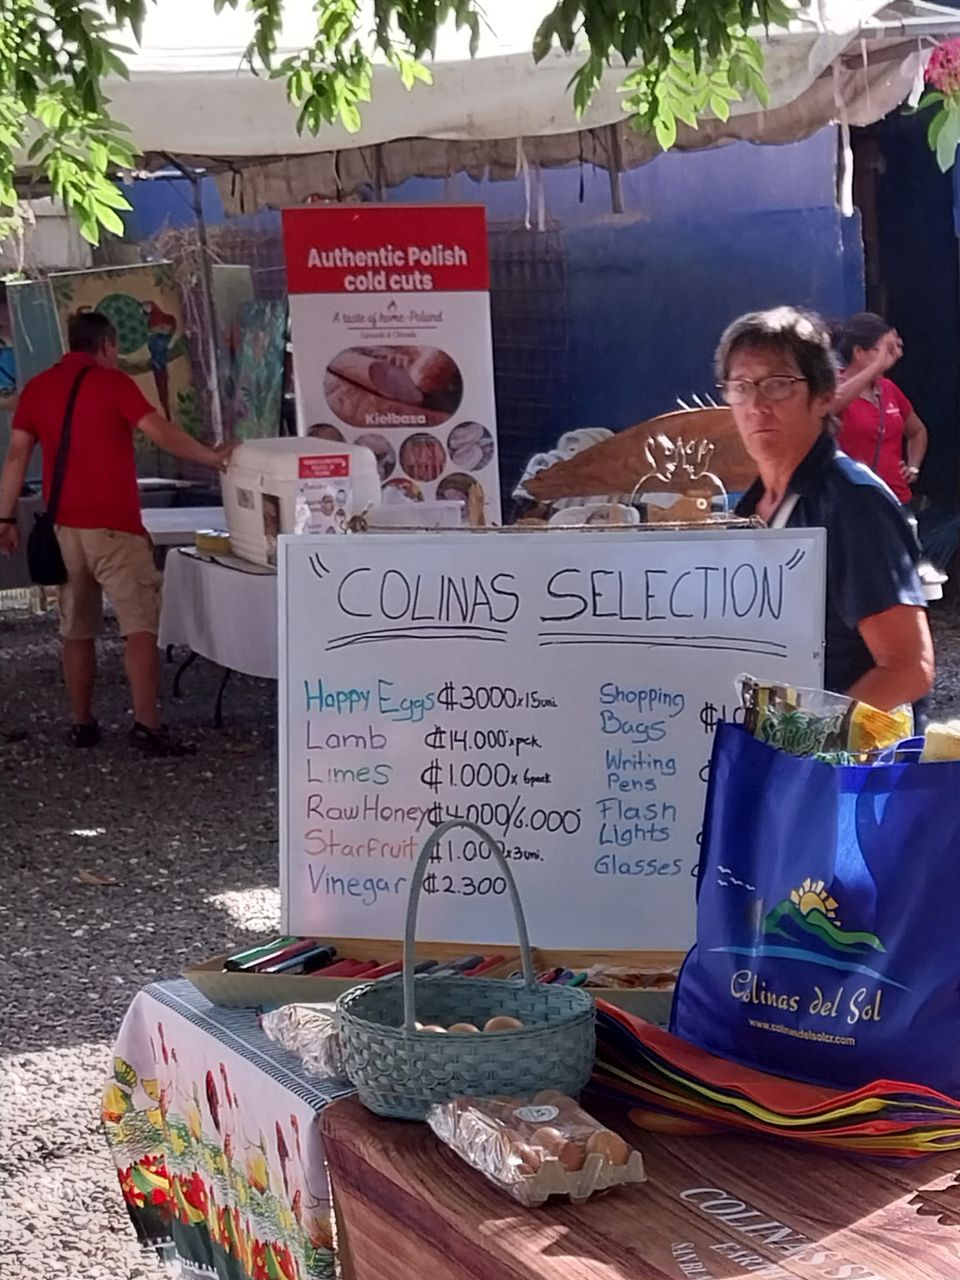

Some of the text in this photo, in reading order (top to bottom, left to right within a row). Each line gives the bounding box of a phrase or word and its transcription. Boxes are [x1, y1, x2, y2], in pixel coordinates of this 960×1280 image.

[307, 244, 468, 268] Authentic Polish
[344, 270, 433, 290] cold cuts
[304, 679, 370, 713] Happy
[377, 680, 436, 722] Eggs
[599, 683, 685, 718] Shopping
[307, 720, 387, 750] Lamb
[600, 709, 667, 743] Bags
[307, 759, 393, 785] Limes
[605, 749, 677, 776] Writing
[607, 772, 658, 793] Pens
[596, 798, 676, 822] Flash
[304, 829, 418, 857] Starfruit
[599, 823, 670, 847] Lights
[594, 854, 683, 877] Glasses
[308, 863, 408, 906] Vinegar
[730, 969, 882, 1025] Colinas del Sol
[680, 1187, 839, 1267] COLINAS
[671, 1242, 702, 1263] SAN
